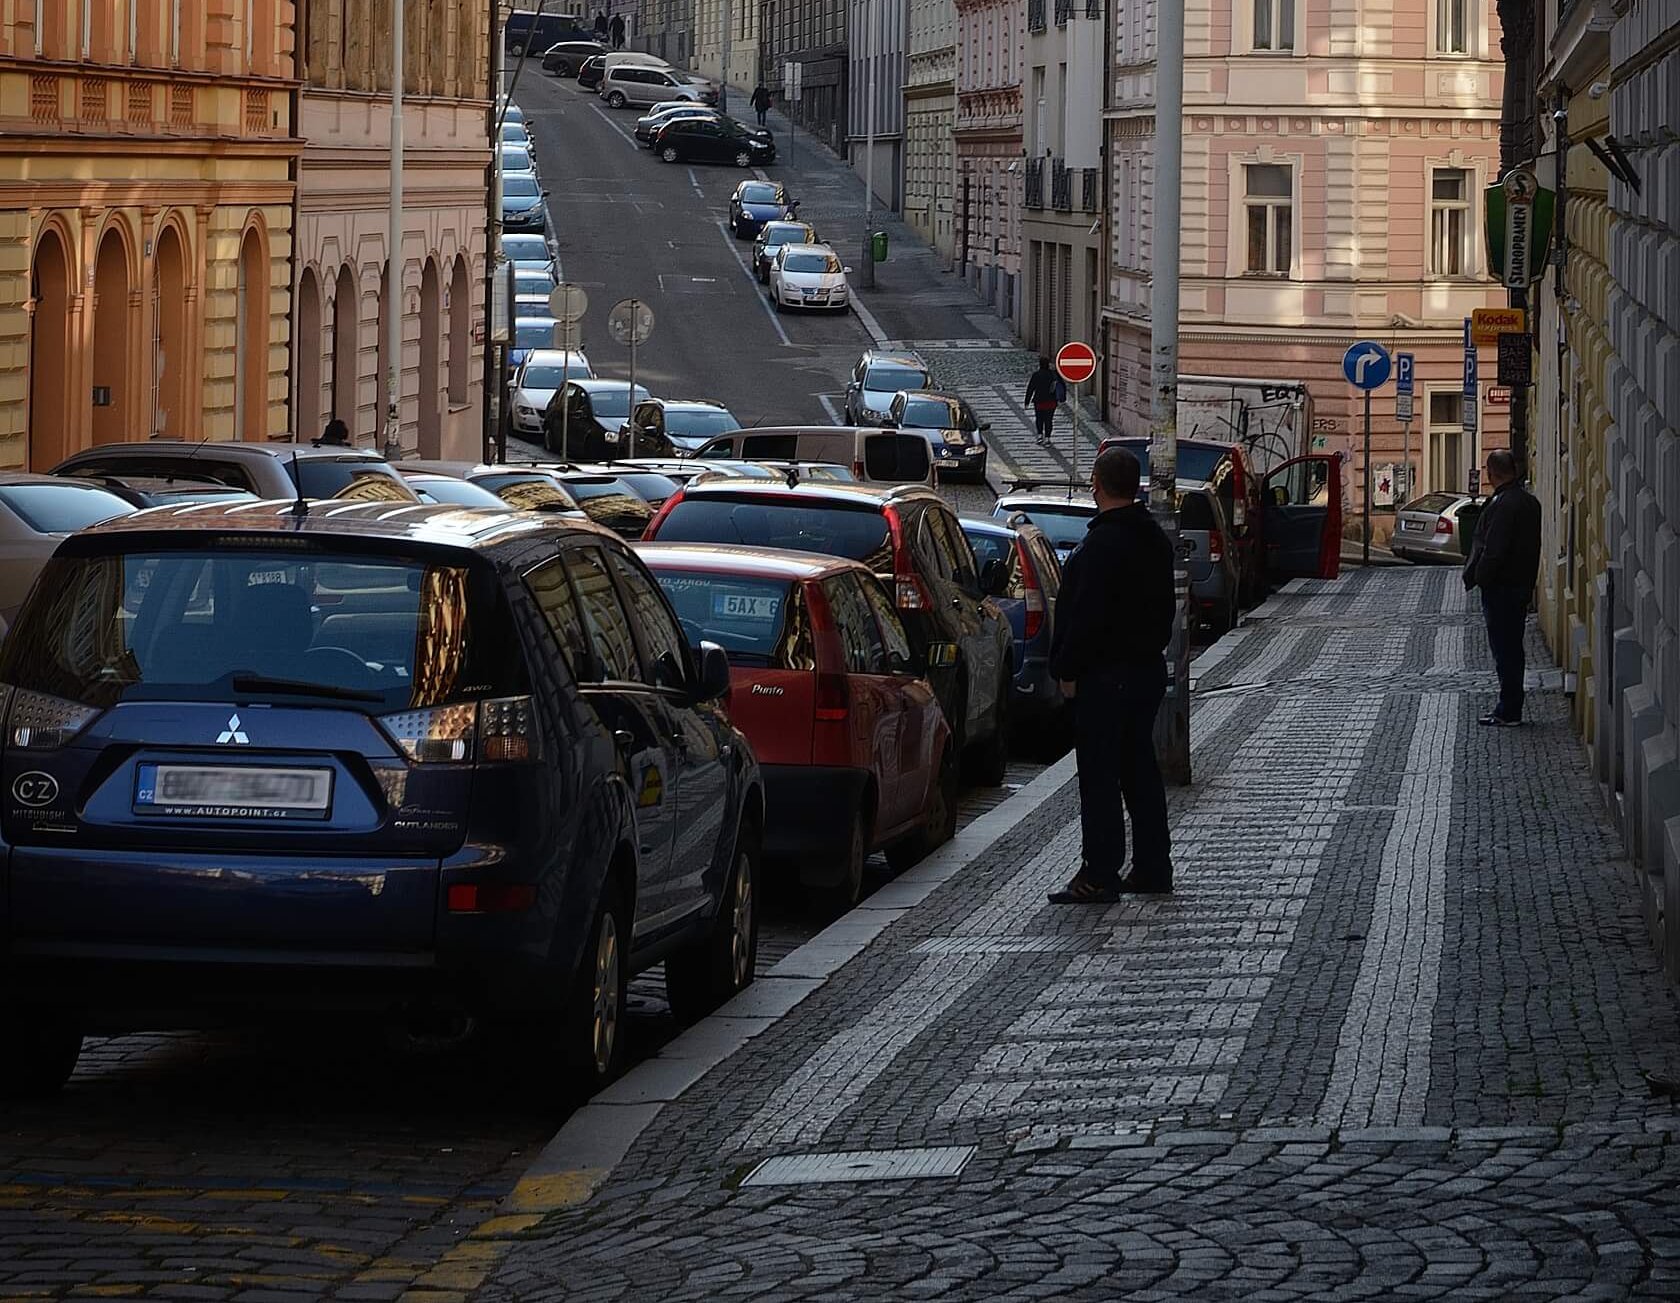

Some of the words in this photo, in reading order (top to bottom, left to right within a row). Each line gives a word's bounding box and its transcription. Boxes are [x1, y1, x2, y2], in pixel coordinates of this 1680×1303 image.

[1509, 206, 1527, 284] STAROPRAMEN
[1478, 313, 1519, 325] Kodak
[727, 598, 756, 615] 5AX
[752, 684, 784, 696] Punto
[19, 780, 51, 799] CZ
[139, 789, 153, 799] CZ
[165, 807, 287, 817] www.AUTOPOINT.cz
[394, 820, 459, 830] OUTLANDER
